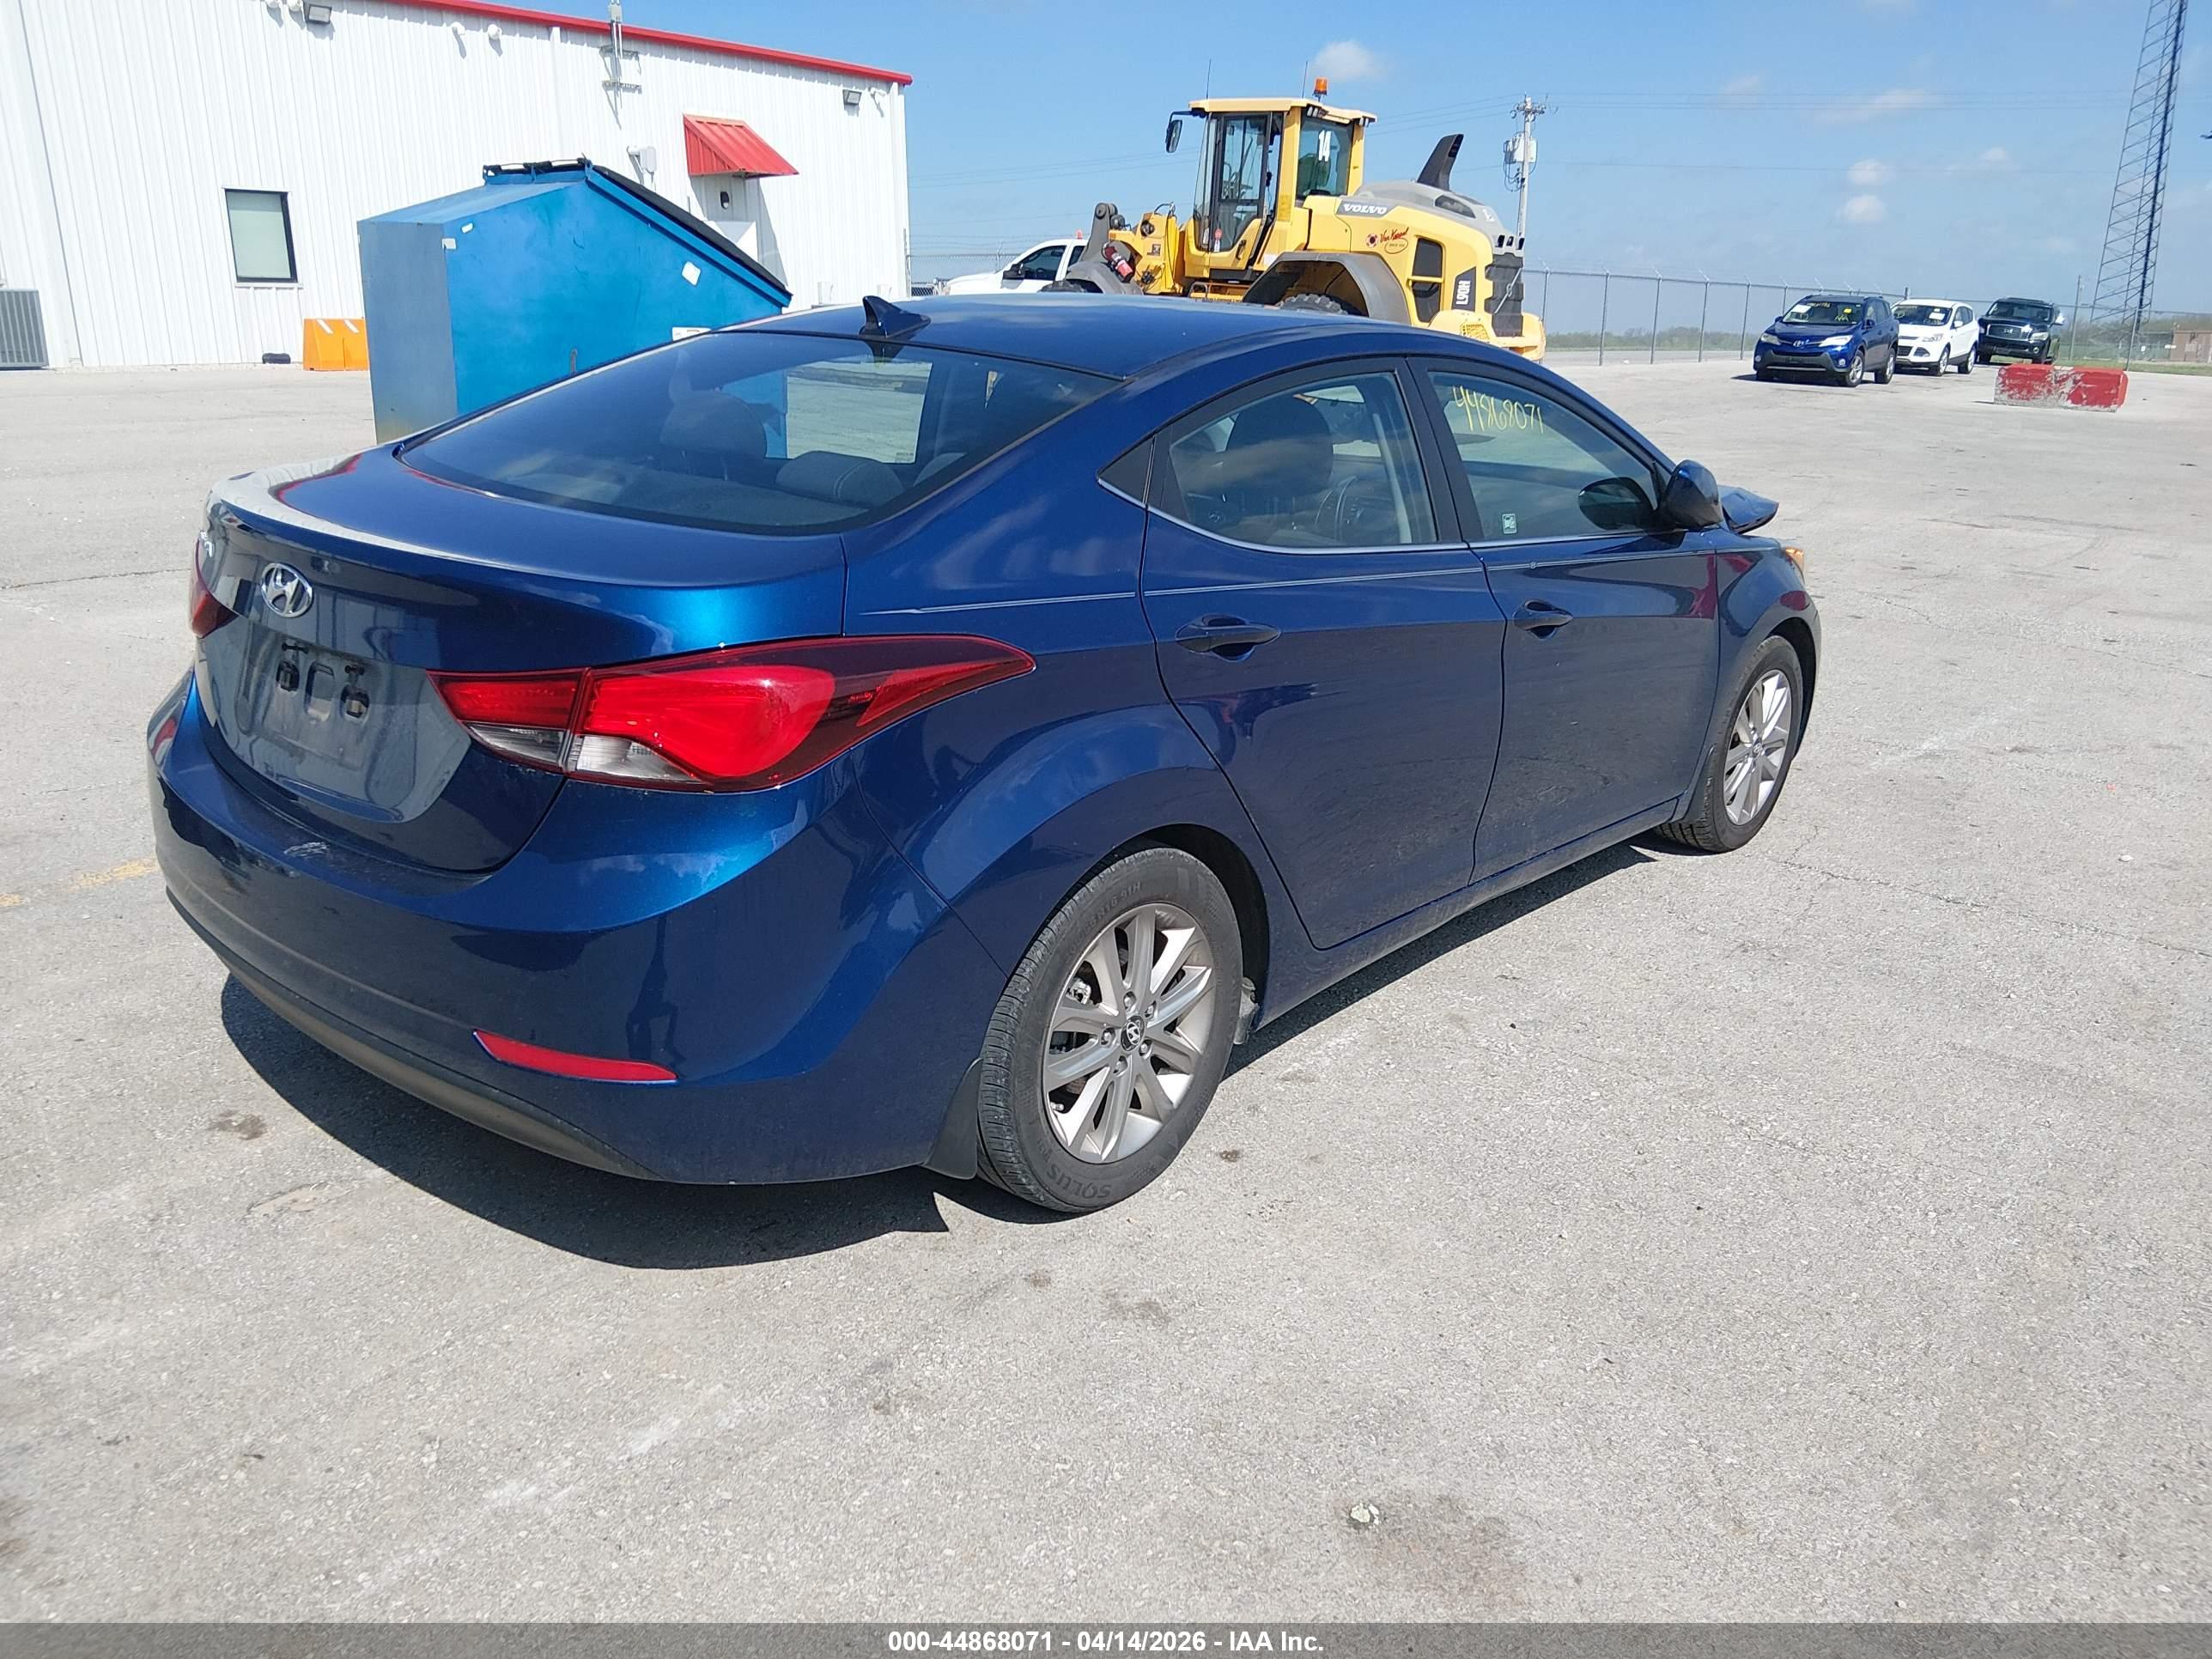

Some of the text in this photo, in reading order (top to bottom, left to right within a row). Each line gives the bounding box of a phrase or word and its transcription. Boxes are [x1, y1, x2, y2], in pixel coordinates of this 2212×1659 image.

[1318, 130, 1332, 162] 14
[1343, 204, 1388, 215] VOLVO
[1455, 280, 1471, 305] L90H
[1452, 386, 1544, 434] 44868071
[1047, 1164, 1112, 1199] SOLUS
